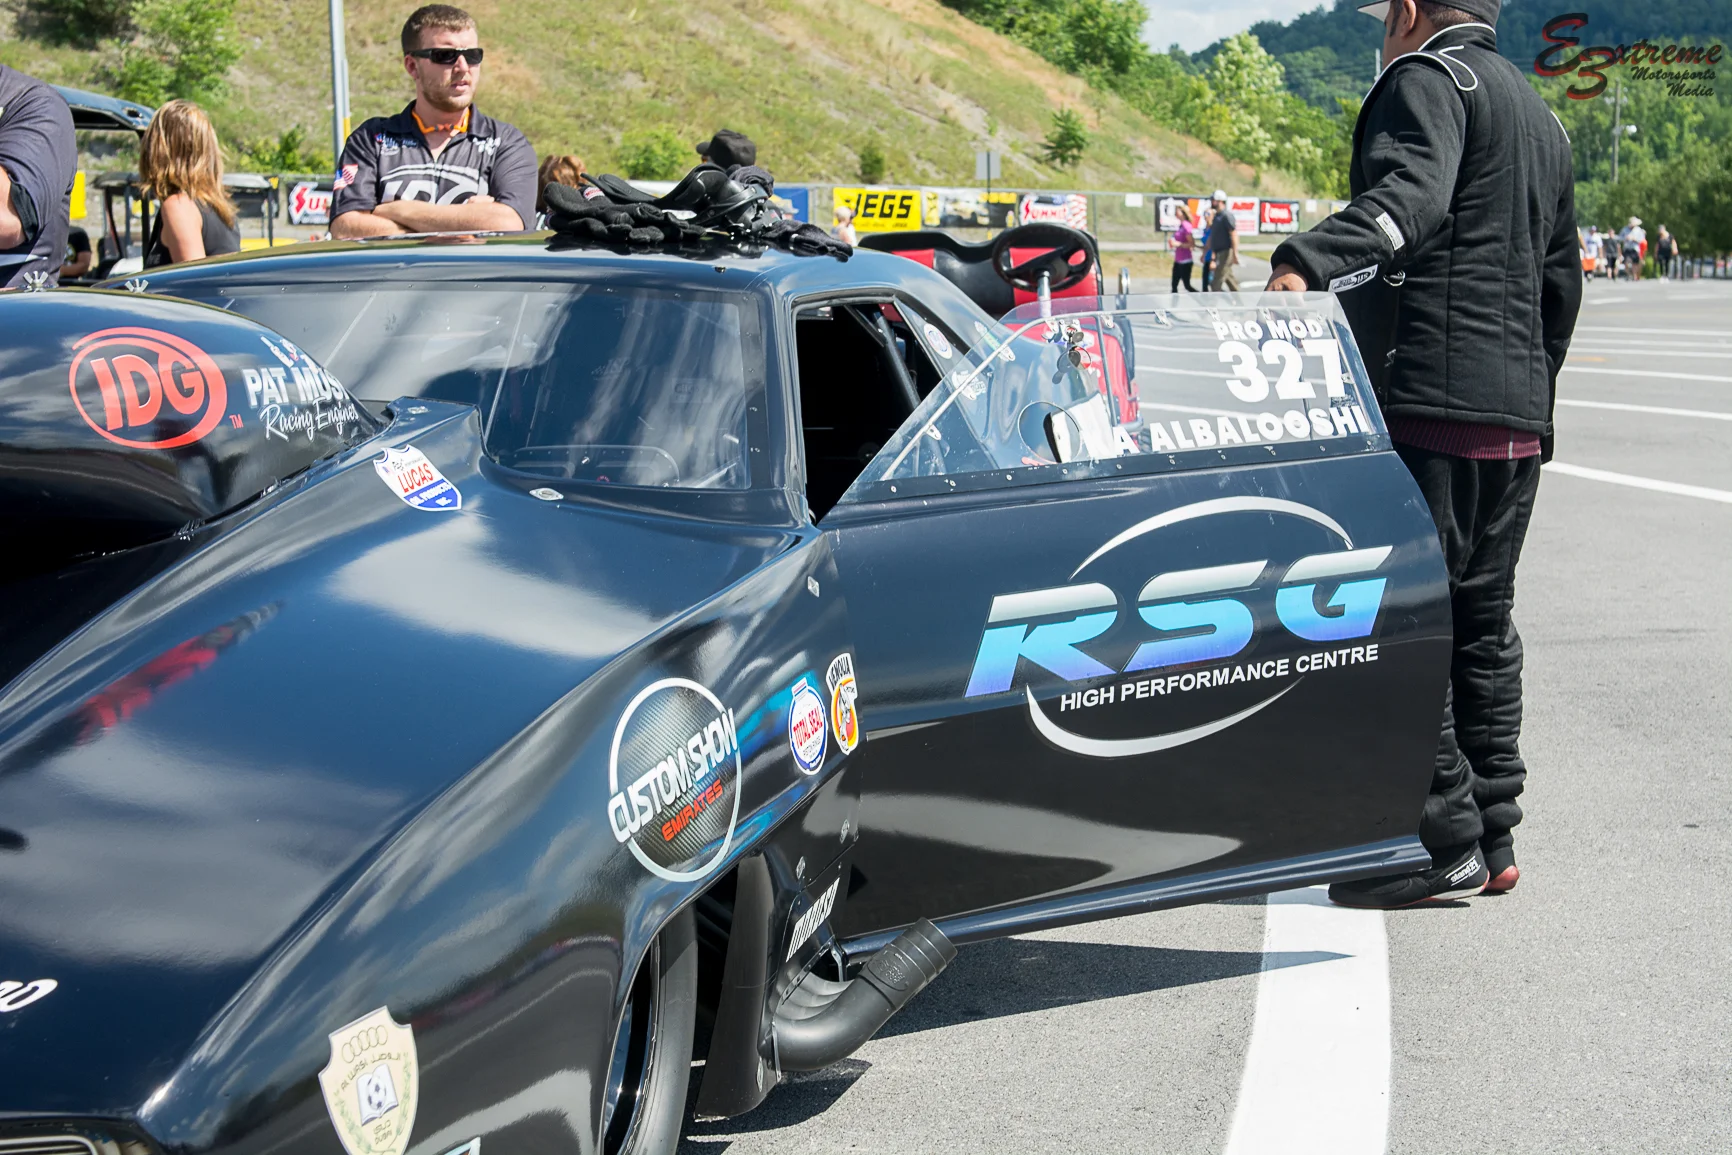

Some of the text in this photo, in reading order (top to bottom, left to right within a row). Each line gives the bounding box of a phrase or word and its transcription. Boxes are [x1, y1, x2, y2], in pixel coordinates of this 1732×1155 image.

[850, 194, 913, 218] JEGS
[1211, 319, 1324, 341] PRO MOD
[90, 351, 205, 431] IDG
[242, 367, 289, 409] PAT
[1217, 338, 1346, 403] 327
[259, 396, 359, 442] Racing Engines
[1149, 405, 1370, 453] ALBALOOSHI
[397, 462, 434, 494] LUCAS
[964, 545, 1394, 699] RSG
[1060, 643, 1379, 712] HIGH PERFORMANCE CENTRE
[793, 716, 812, 749] TOTAL
[808, 705, 824, 736] SEAL
[607, 707, 738, 843] CUSTOM SHOW
[661, 778, 723, 842] EMIRATES
